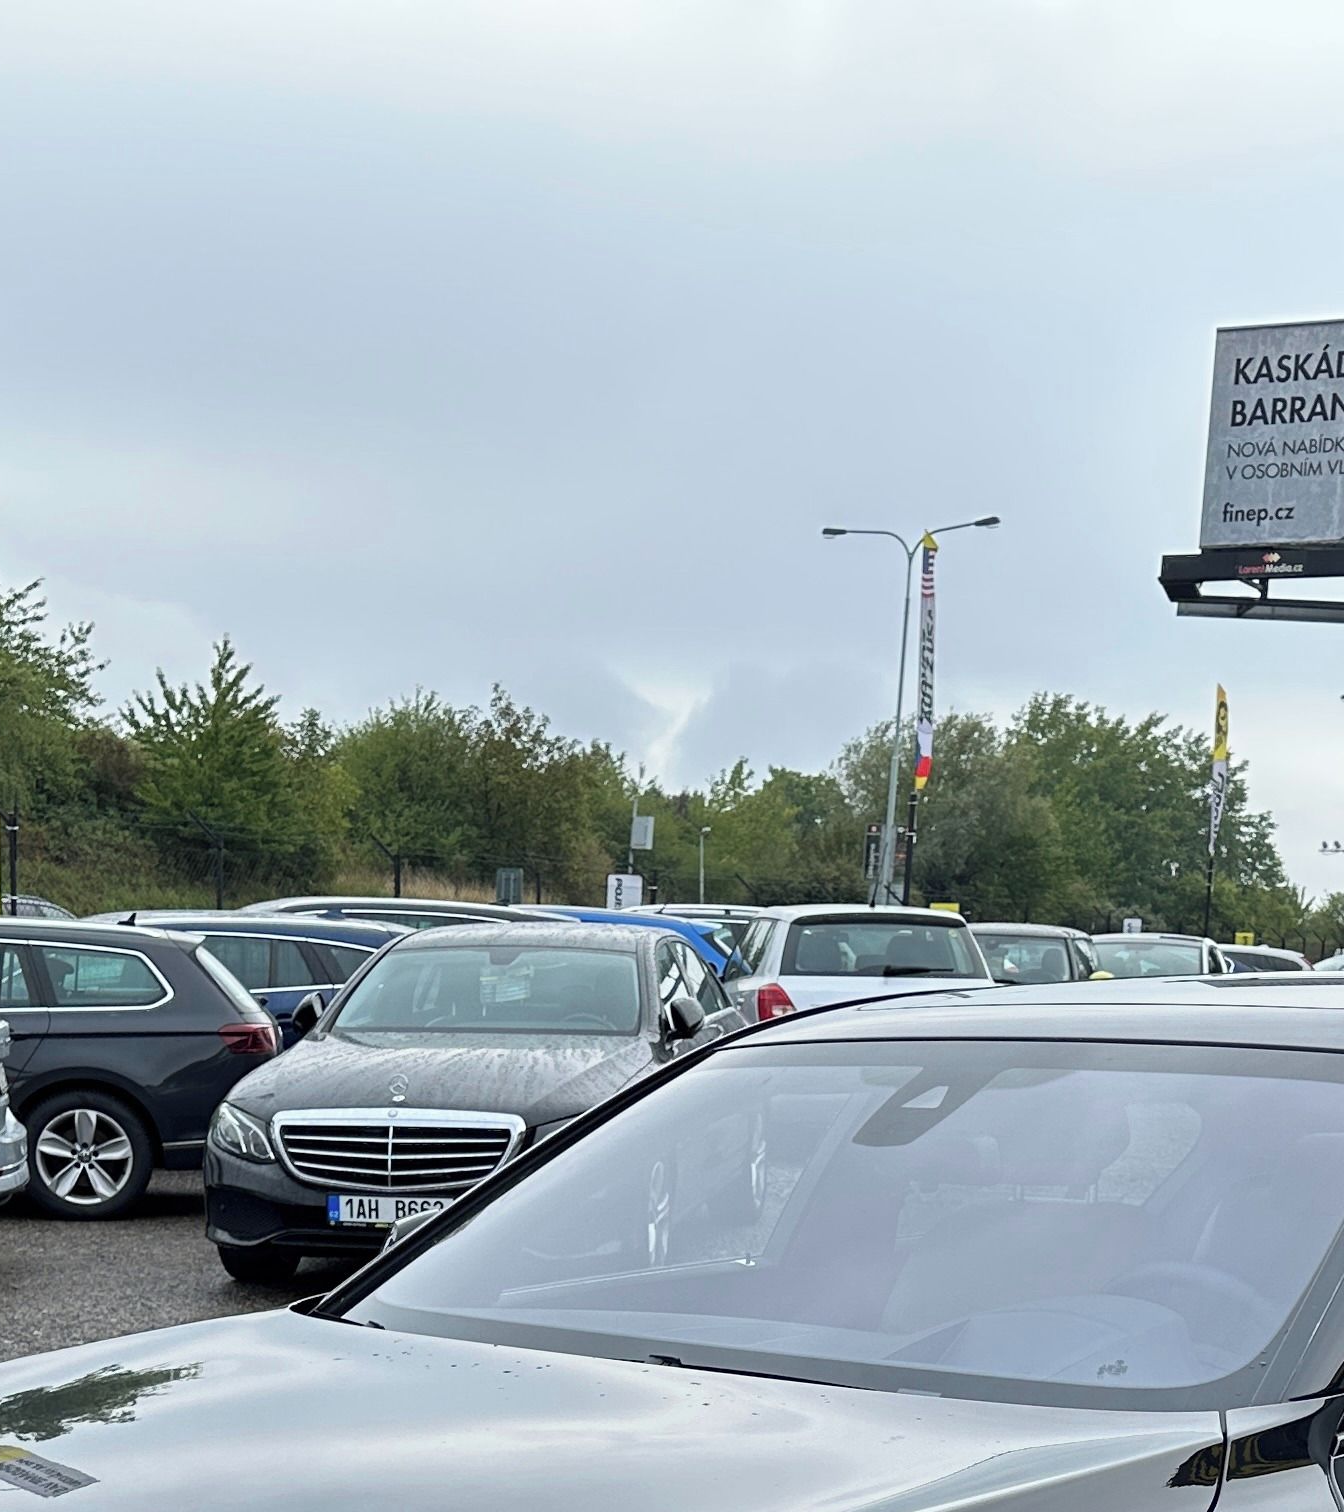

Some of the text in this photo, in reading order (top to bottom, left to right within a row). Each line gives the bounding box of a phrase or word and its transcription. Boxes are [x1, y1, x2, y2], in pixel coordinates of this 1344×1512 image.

[1227, 437, 1278, 458] NOVÁ
[1226, 465, 1237, 480] V
[1241, 457, 1323, 480] OSOBNÍM
[1222, 502, 1295, 526] finep.cz
[345, 1199, 379, 1219] 1AH
